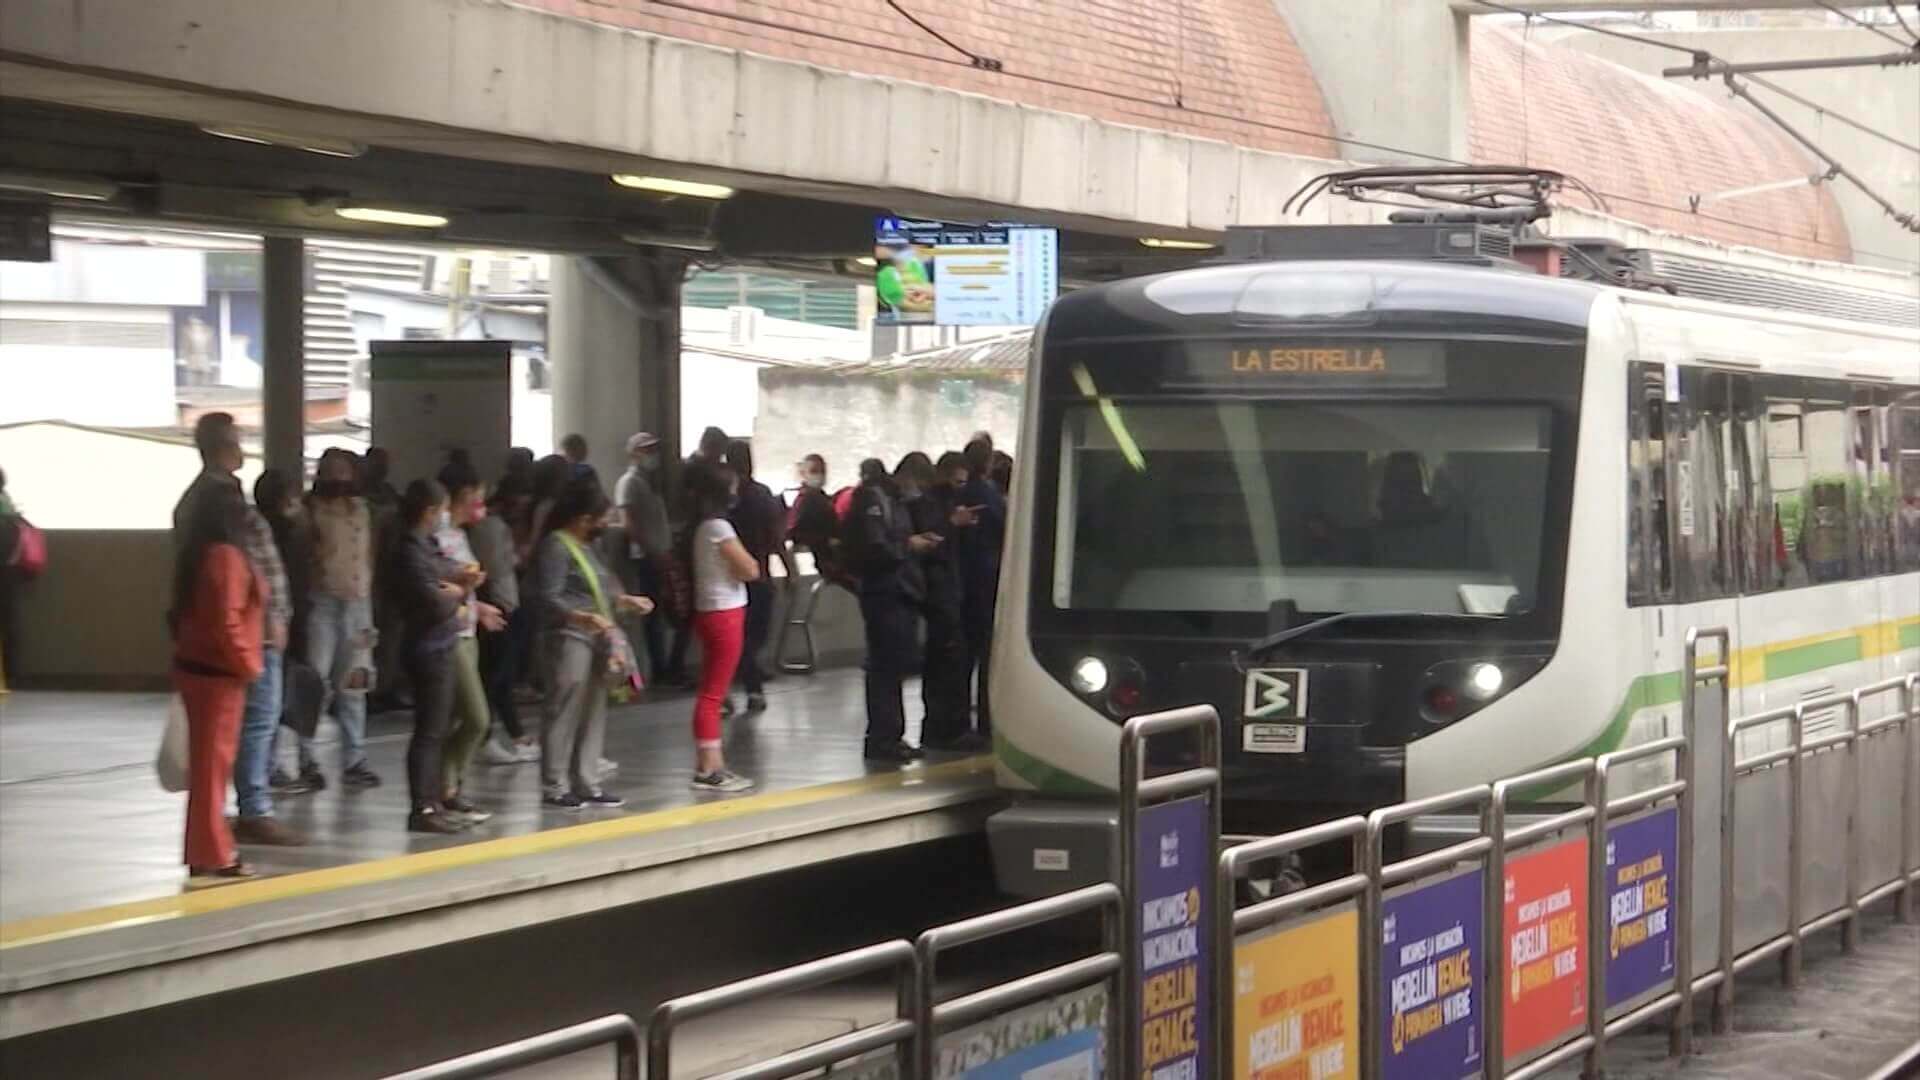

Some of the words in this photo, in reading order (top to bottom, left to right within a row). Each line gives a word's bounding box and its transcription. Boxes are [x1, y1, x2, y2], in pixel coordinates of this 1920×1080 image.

[1232, 350, 1262, 371] LA
[1269, 348, 1386, 372] ESTRELLA
[1511, 918, 1548, 969] MEDELLÍN
[1392, 957, 1437, 1016] MEDELLÍN
[1249, 1008, 1302, 1070] MEDELLÍN
